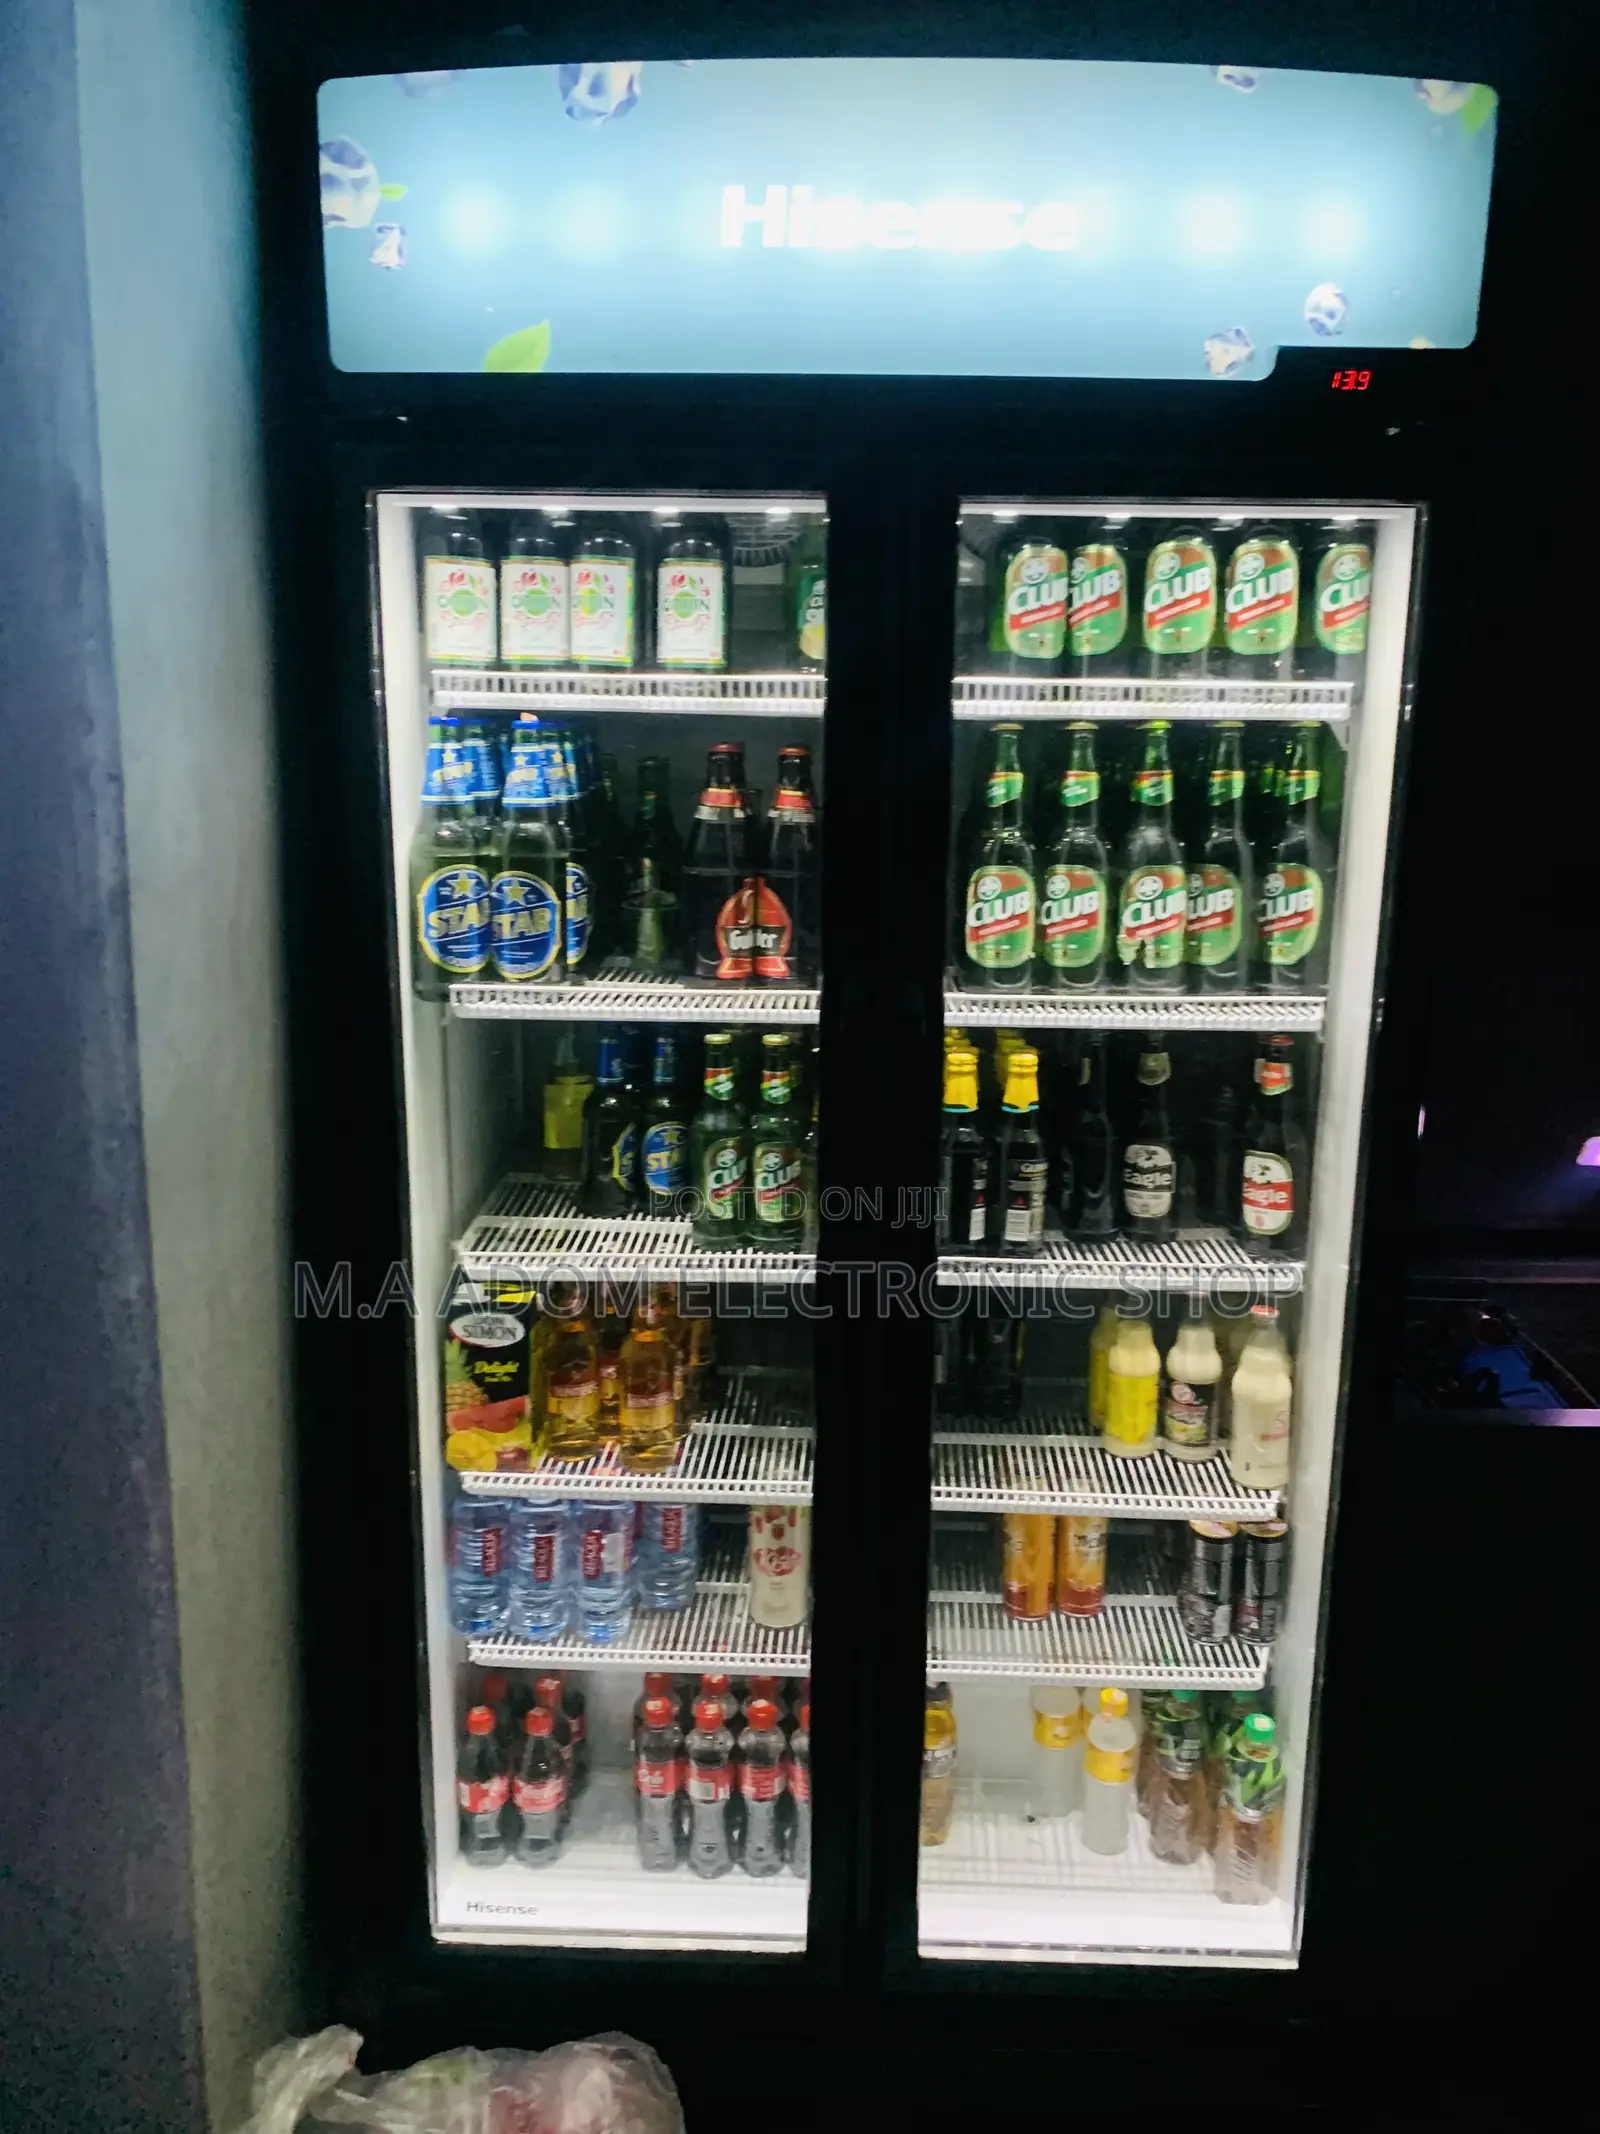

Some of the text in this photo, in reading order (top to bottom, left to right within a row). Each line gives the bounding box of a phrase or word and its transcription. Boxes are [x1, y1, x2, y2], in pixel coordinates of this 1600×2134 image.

[1145, 566, 1212, 612] CLUB
[1225, 567, 1295, 613] CLUB
[1320, 573, 1371, 612] CLU
[967, 891, 1030, 927] CLUB
[1188, 888, 1234, 920] LUB
[466, 1901, 539, 1915] Hisense
